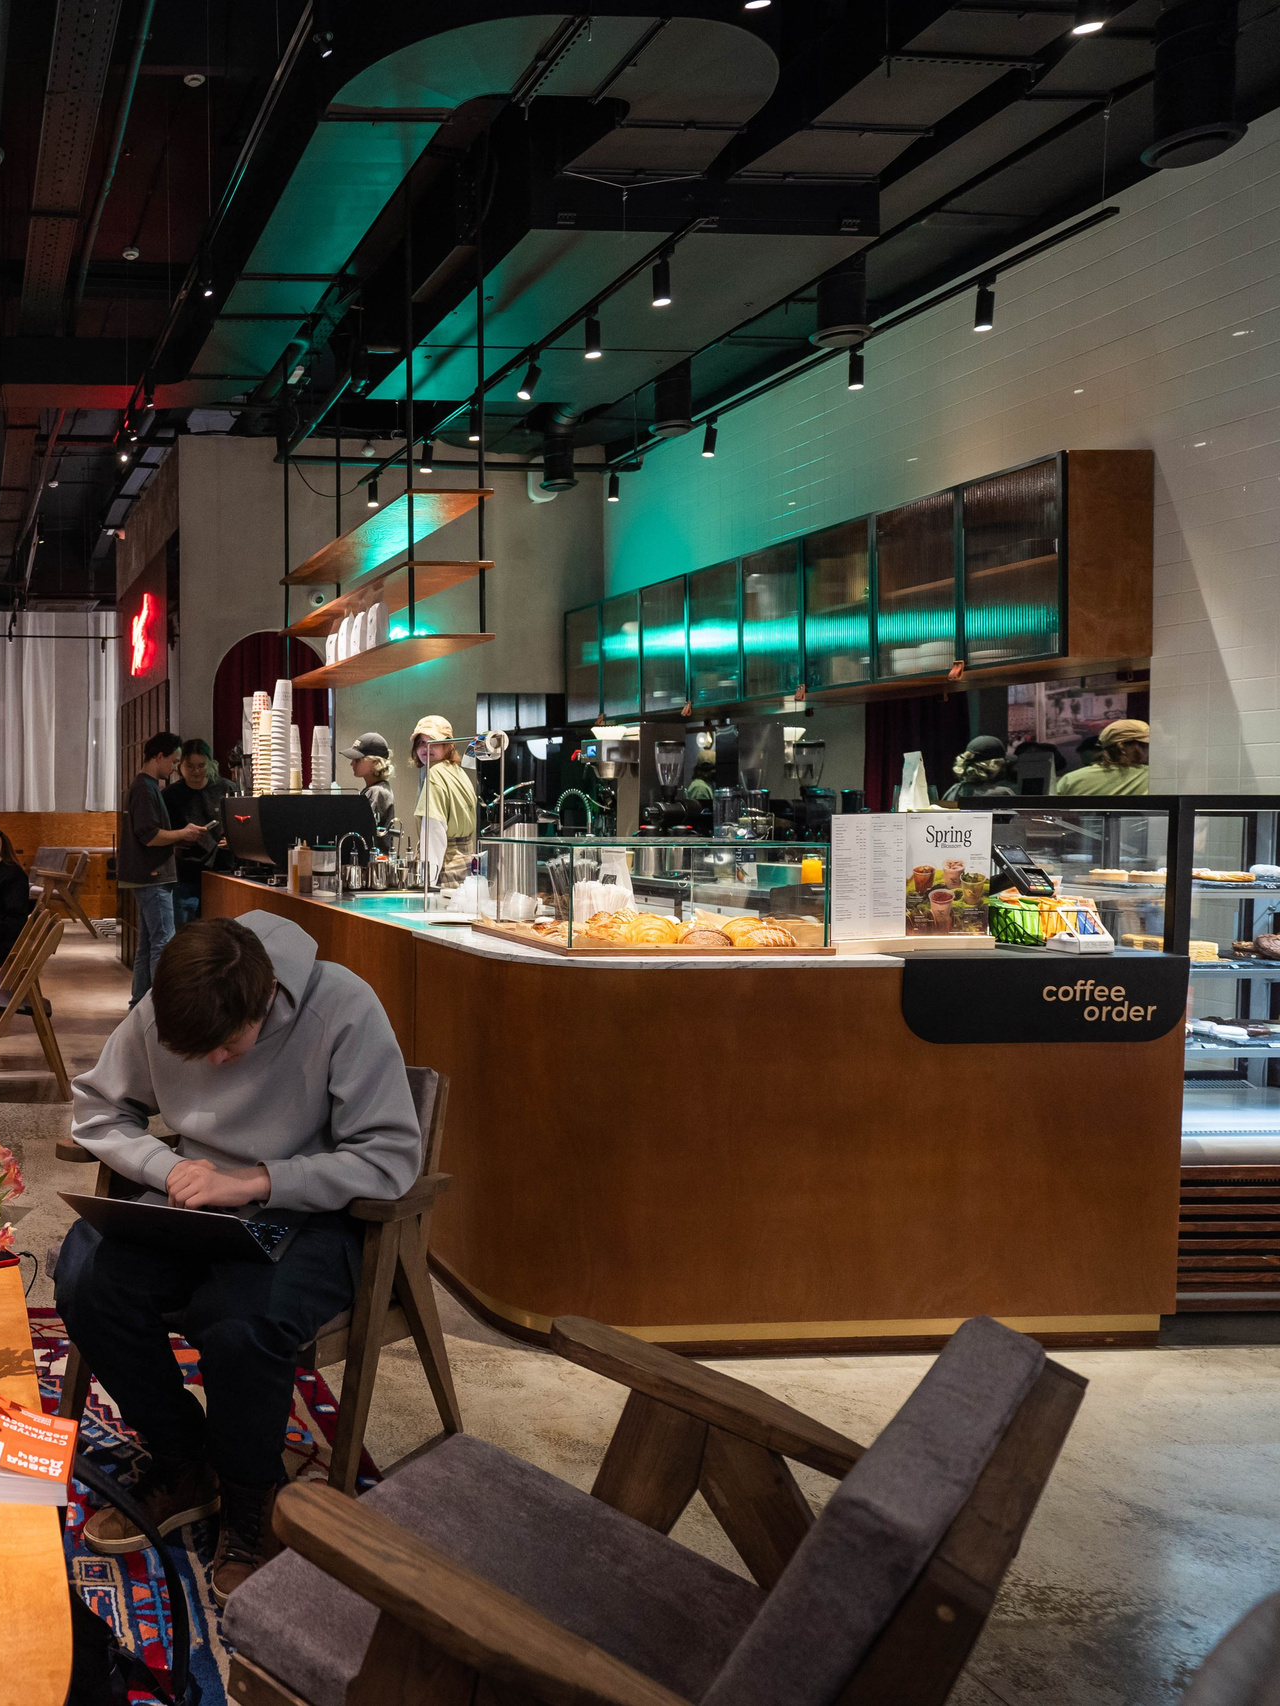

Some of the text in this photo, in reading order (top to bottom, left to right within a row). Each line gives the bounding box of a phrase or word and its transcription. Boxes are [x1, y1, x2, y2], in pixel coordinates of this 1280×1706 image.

[926, 825, 972, 848] Spring
[1042, 979, 1126, 1002] coffee
[1083, 1001, 1157, 1022] order
[2, 1421, 67, 1446] Структура
[6, 1454, 63, 1477] Дэвид
[18, 1451, 64, 1469] Дойч
